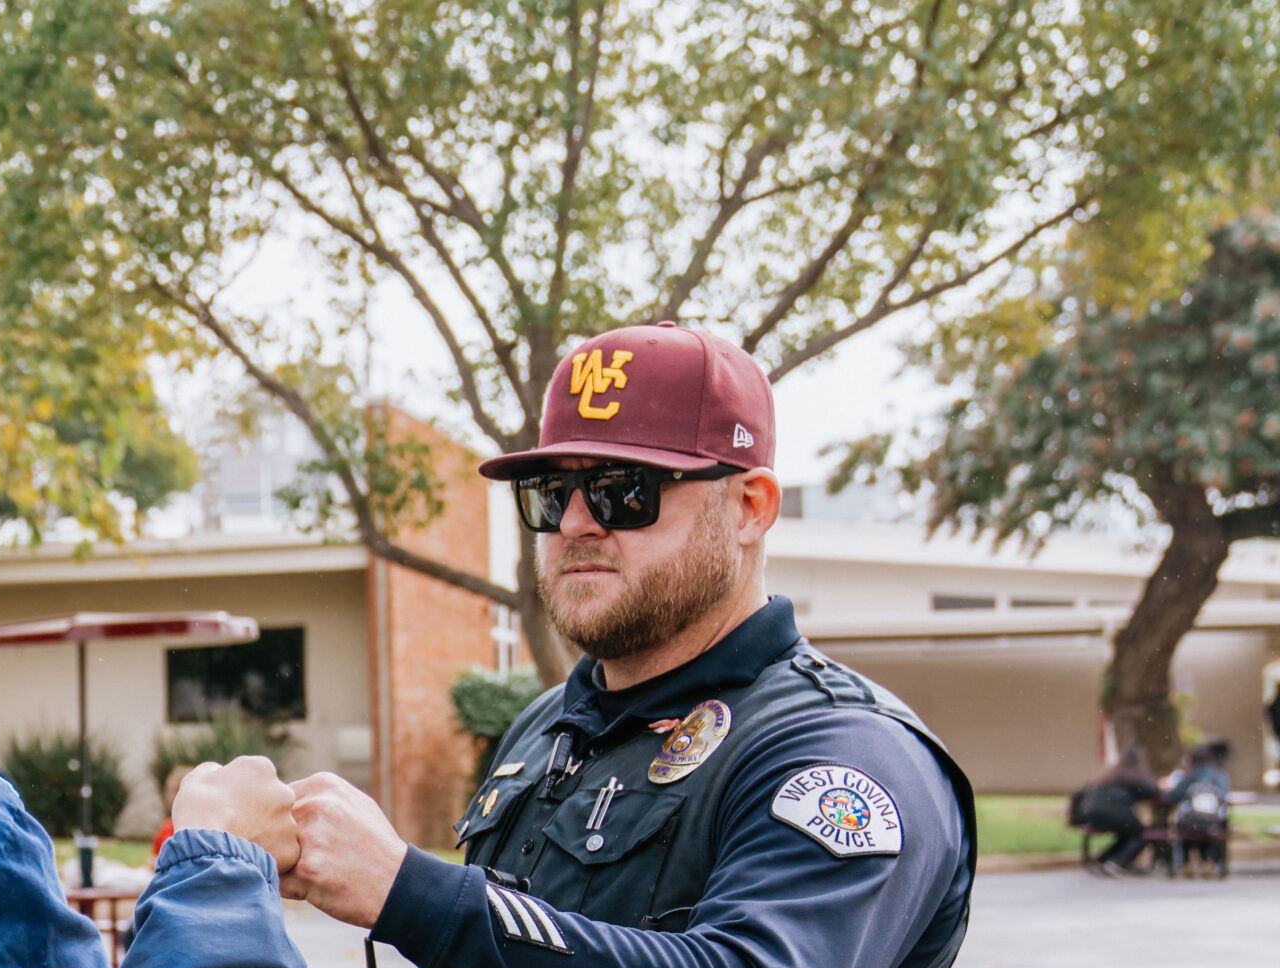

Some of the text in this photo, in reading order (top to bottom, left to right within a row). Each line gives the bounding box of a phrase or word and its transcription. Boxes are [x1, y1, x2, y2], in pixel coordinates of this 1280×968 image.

[779, 769, 898, 831] WEST COVINA
[806, 816, 876, 847] POLICE
